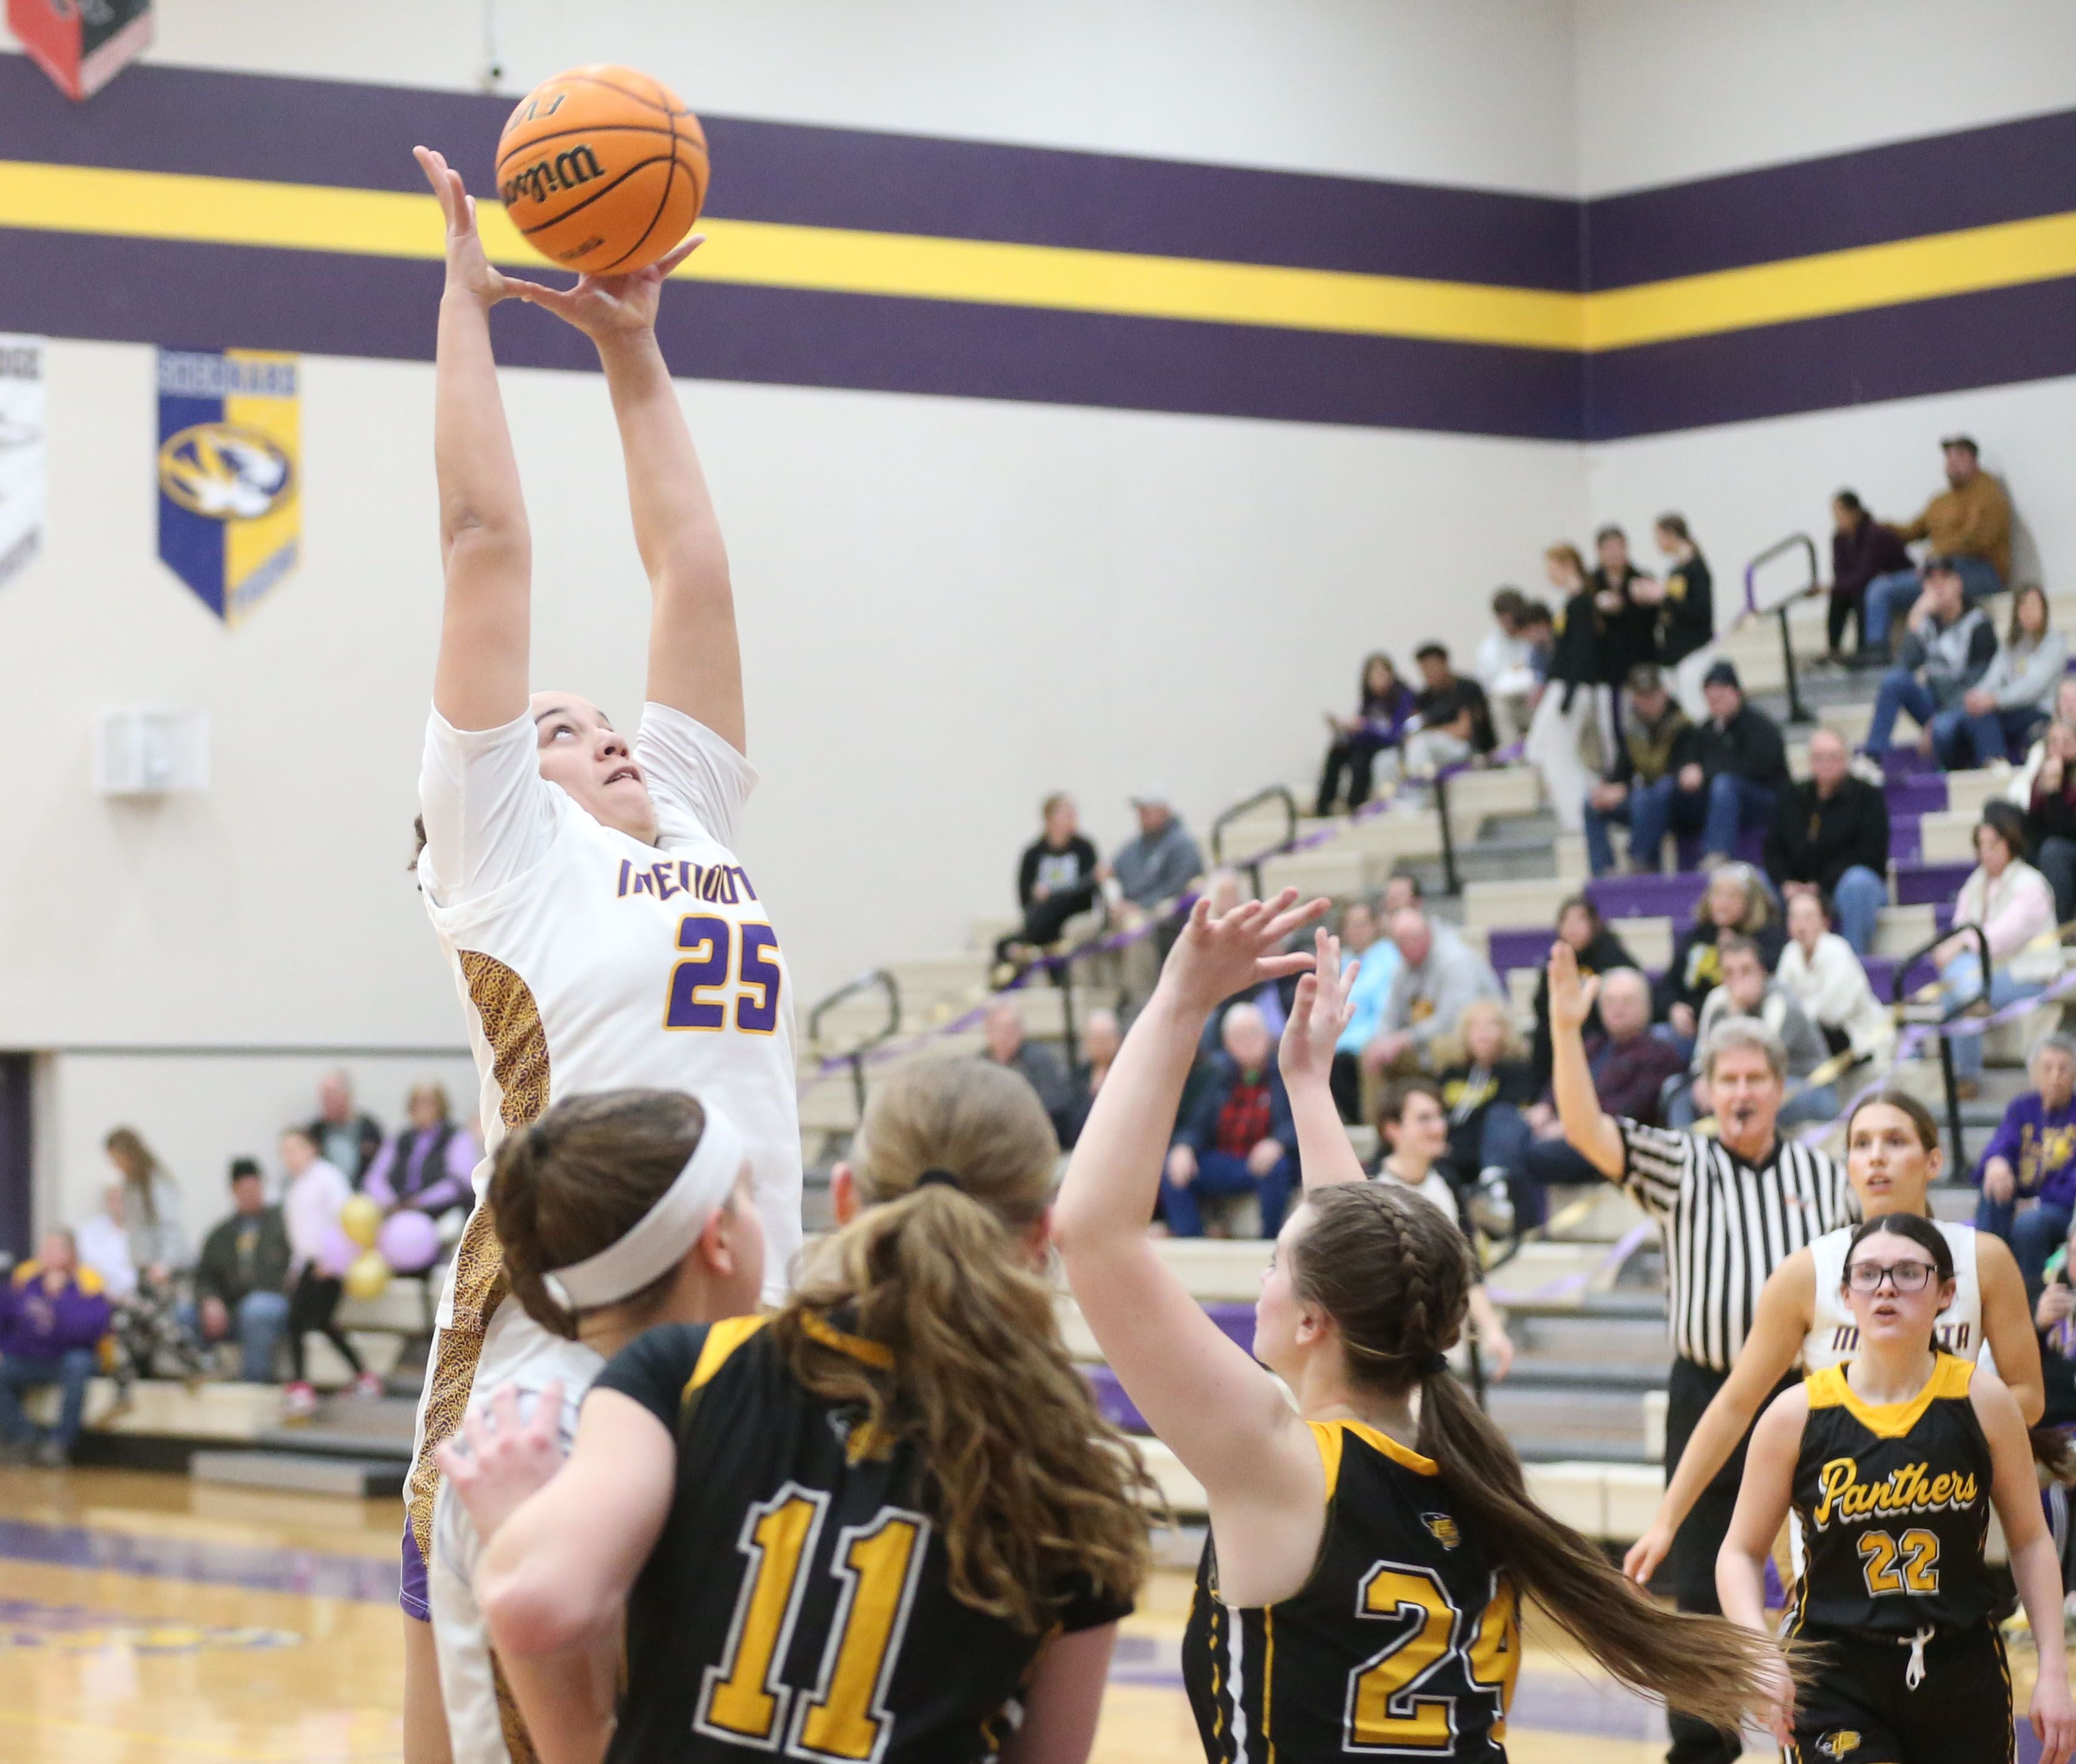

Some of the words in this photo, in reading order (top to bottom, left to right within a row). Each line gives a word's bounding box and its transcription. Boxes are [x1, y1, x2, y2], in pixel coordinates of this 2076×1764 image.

[503, 144, 605, 209] Wilso
[617, 858, 759, 904] MENDOT
[662, 912, 781, 1036] 25
[1813, 1457, 1977, 1533] Panthers
[1857, 1528, 1939, 1599] 22
[693, 1480, 932, 1764] 11
[1343, 1560, 1520, 1756] 24
